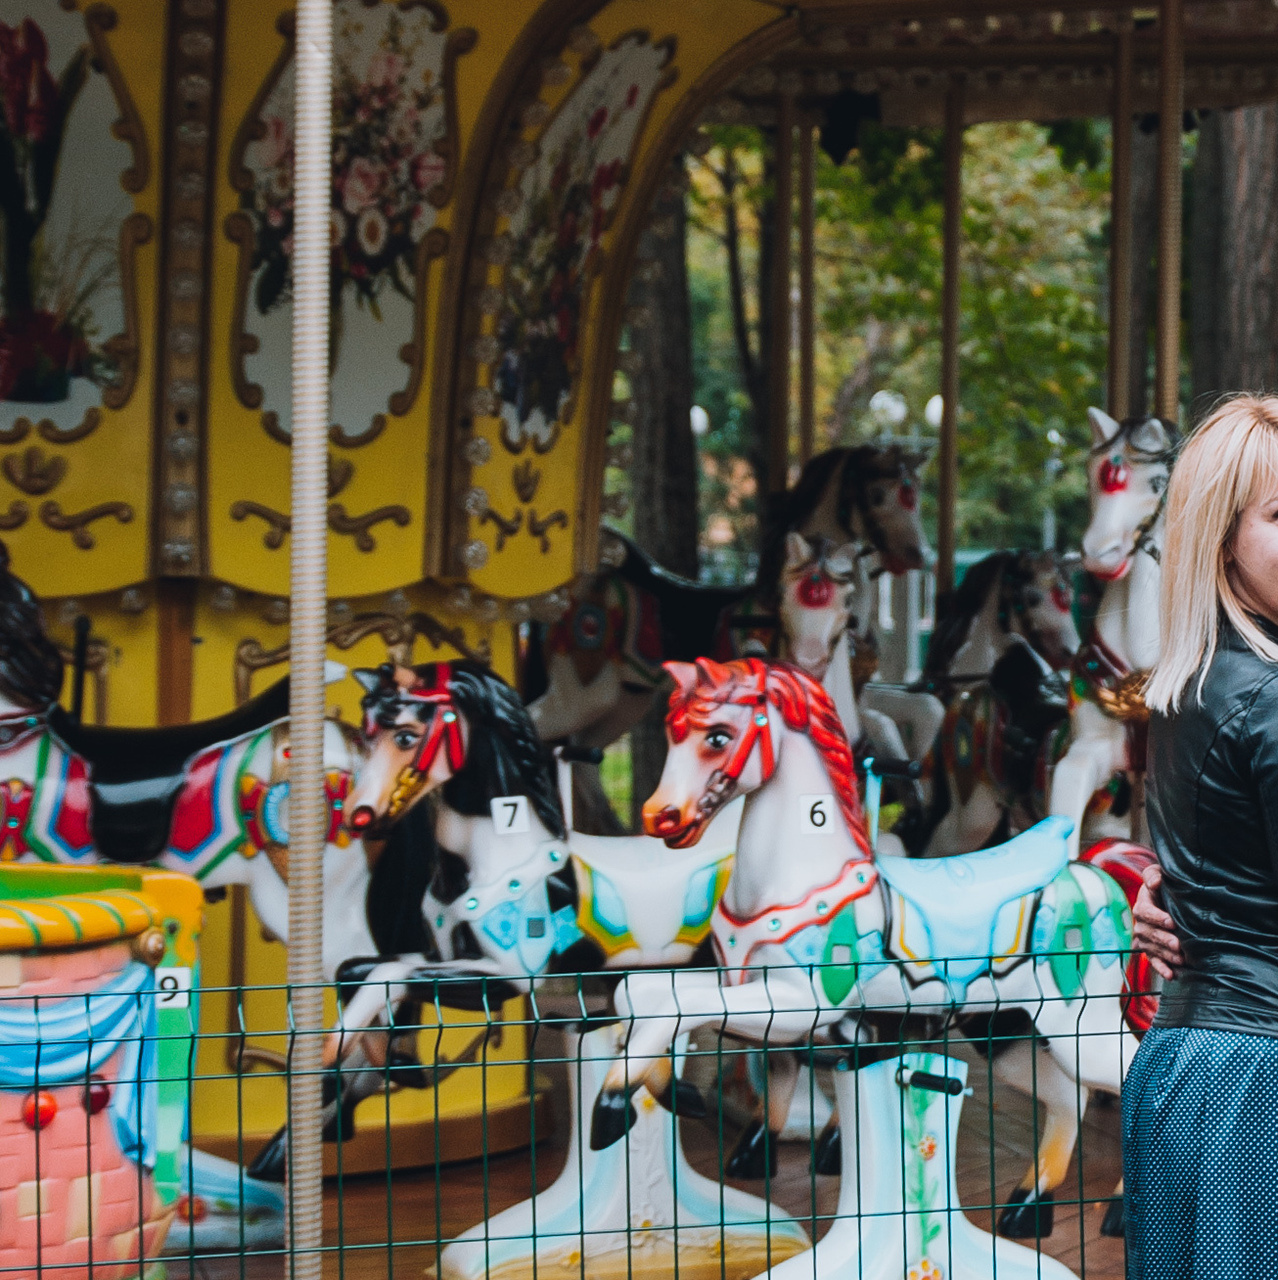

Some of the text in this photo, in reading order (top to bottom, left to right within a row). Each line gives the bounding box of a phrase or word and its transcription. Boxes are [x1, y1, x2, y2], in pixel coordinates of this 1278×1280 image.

[503, 802, 518, 827] 7
[810, 800, 826, 827] 6
[160, 975, 178, 1002] 9
